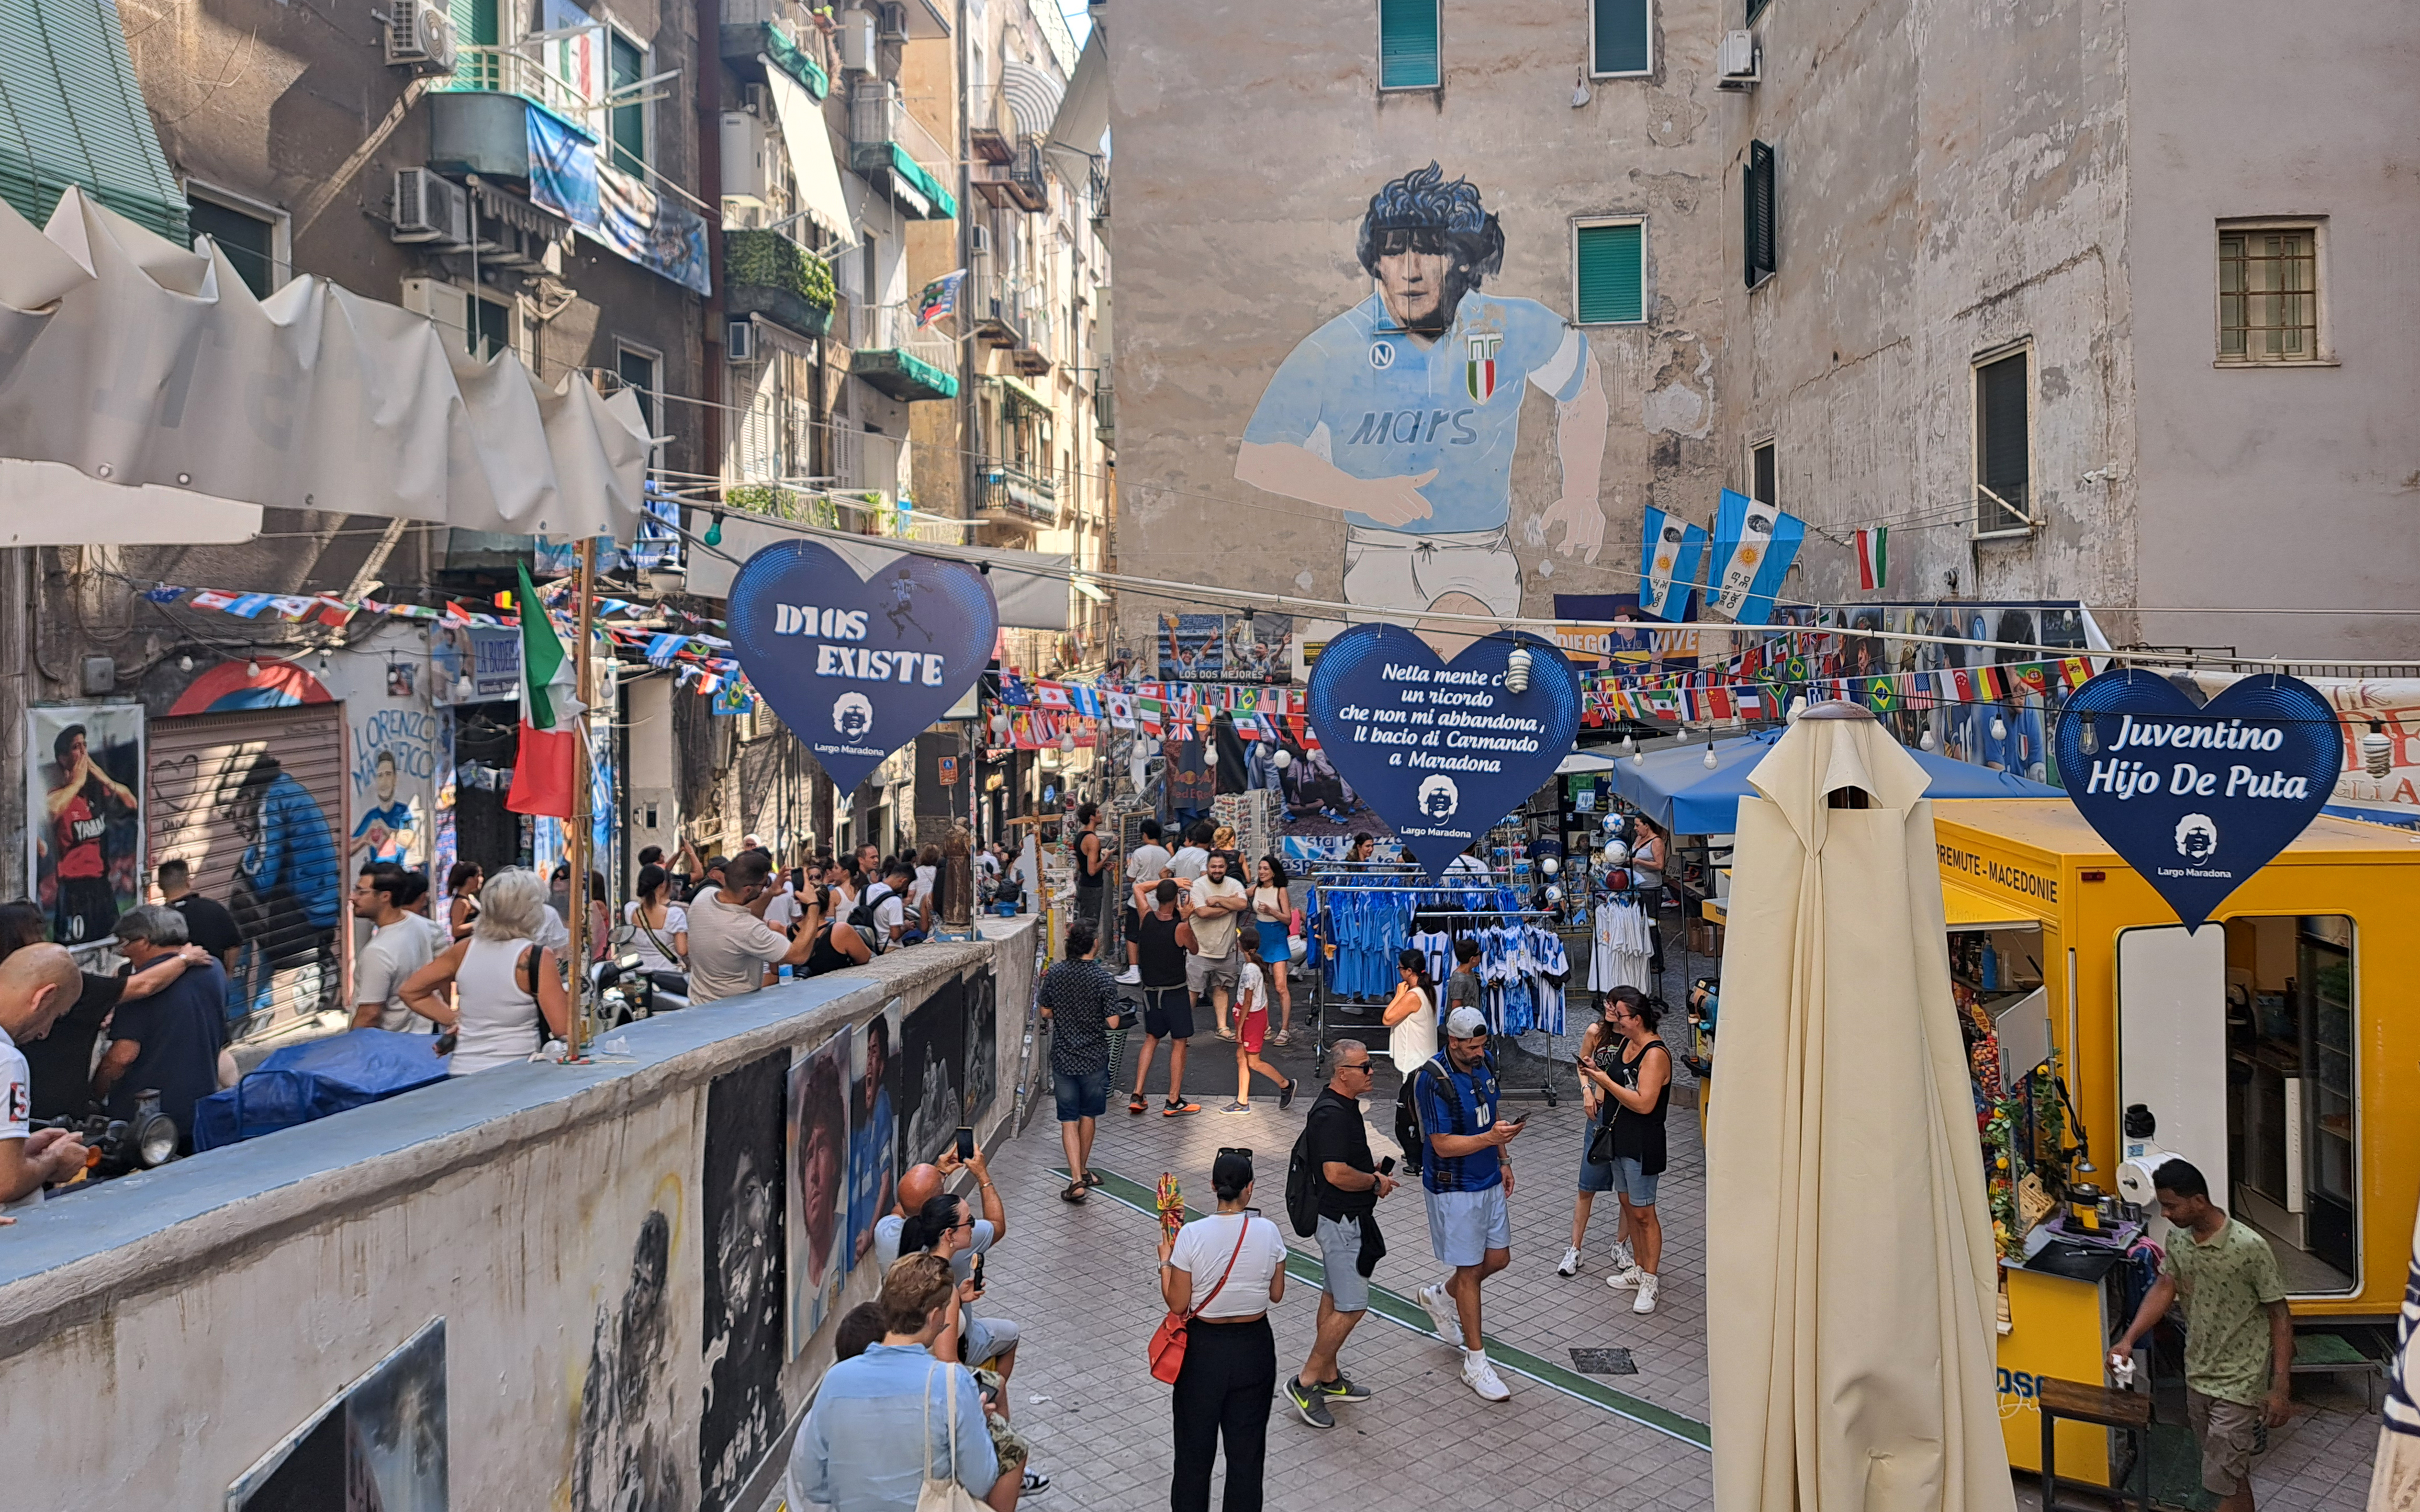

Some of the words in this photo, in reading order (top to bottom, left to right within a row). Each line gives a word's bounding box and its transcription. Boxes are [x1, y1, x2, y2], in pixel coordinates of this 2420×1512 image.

[1556, 634, 1611, 653] DIEGO
[1649, 629, 1699, 652] VIVE
[815, 644, 944, 687] EXISTE
[1179, 670, 1197, 679] LOS
[1199, 670, 1218, 679] DOS
[1220, 669, 1264, 679] MEJORES
[1382, 662, 1430, 682] Nella
[1432, 670, 1487, 686] mente
[1401, 689, 1425, 704] un
[1428, 688, 1494, 707] ricordo
[1339, 704, 1369, 721] che
[1372, 708, 1407, 723] non
[1410, 708, 1435, 725] mi
[353, 709, 435, 760] LORENZO
[1370, 726, 1418, 746] bacio
[1421, 729, 1441, 747] di
[1446, 730, 1539, 753] Carmando
[2108, 714, 2284, 752] Juventino
[814, 742, 840, 754] Largo
[841, 744, 885, 757] Maradona
[1388, 752, 1402, 766] a
[1407, 750, 1502, 773] Maradona
[2086, 758, 2161, 800] Hijo
[2169, 762, 2217, 797] De
[2225, 764, 2310, 800] Puta
[1401, 825, 1426, 837] Largo
[1427, 827, 1472, 839] Maradona
[1989, 860, 2057, 904] MACEDONIE
[2157, 866, 2185, 878] Largo
[2186, 867, 2232, 879] Maradona
[1475, 1102, 1491, 1128] 10
